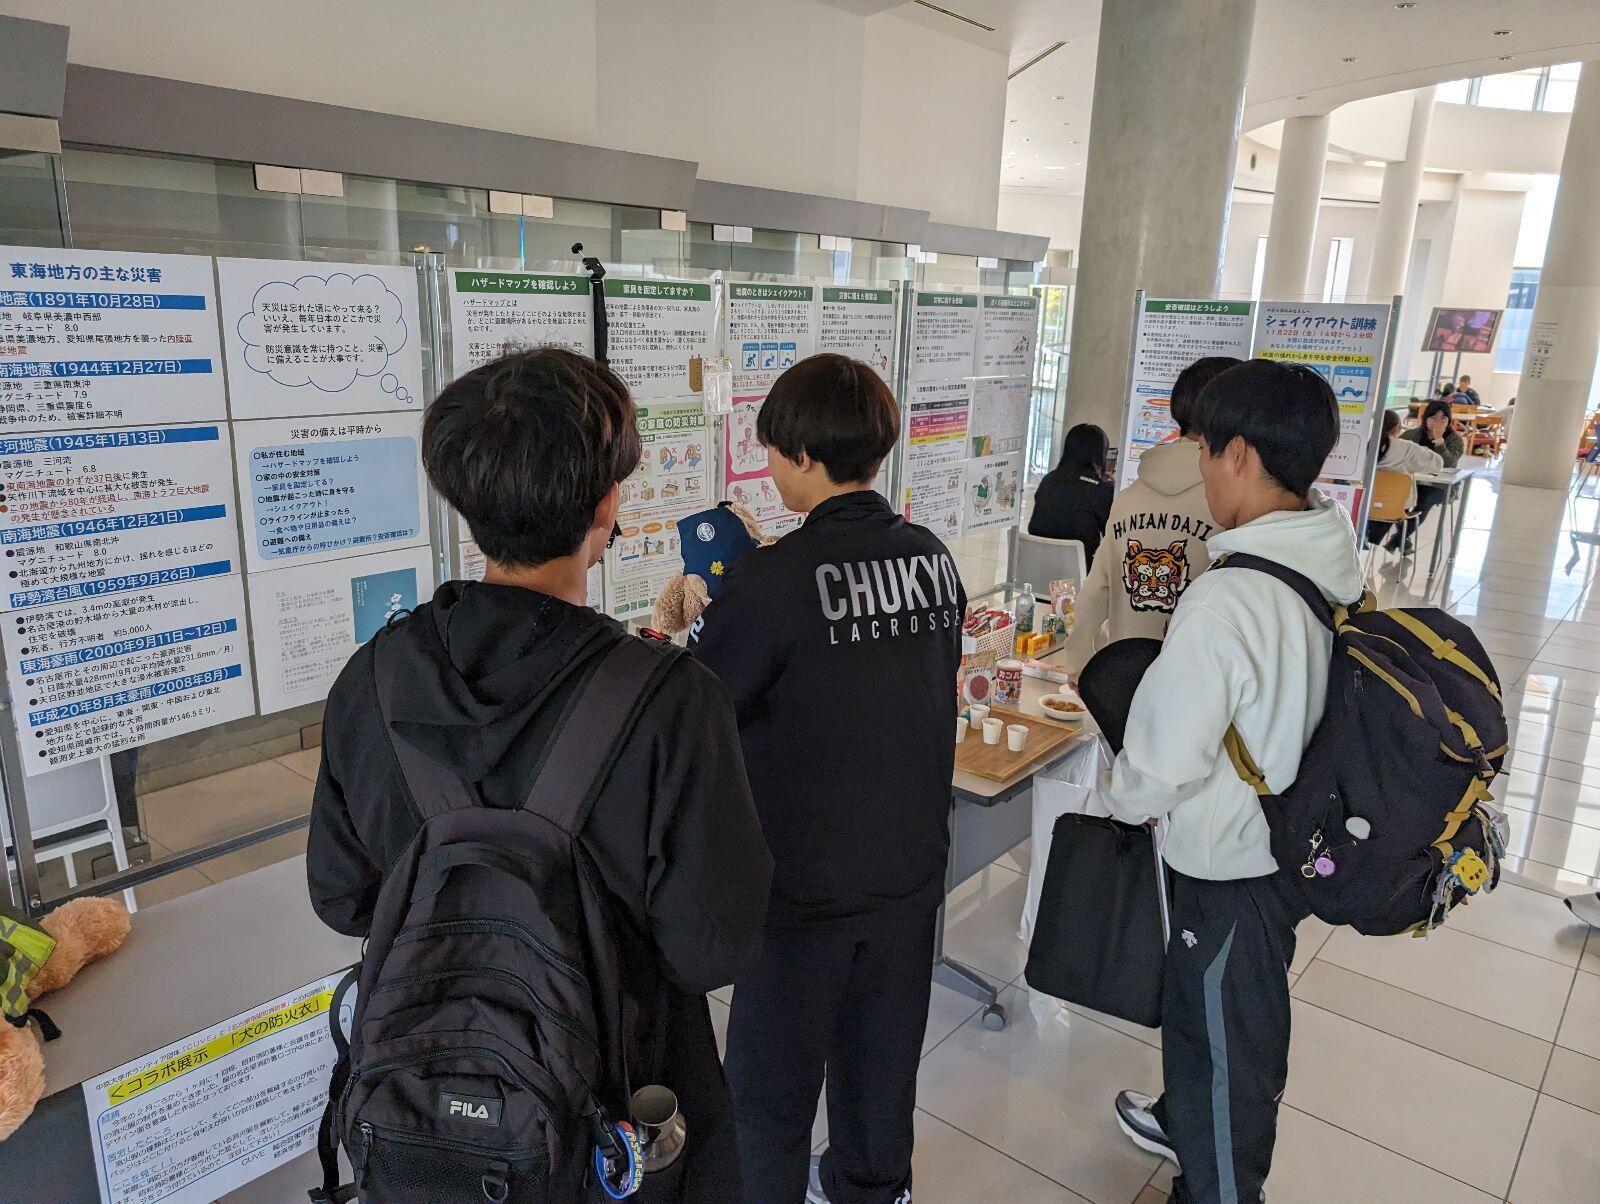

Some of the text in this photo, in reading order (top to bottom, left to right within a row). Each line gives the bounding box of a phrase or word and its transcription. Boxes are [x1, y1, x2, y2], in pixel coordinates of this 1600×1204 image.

[9, 262, 162, 284] 東海地方の主な災害
[471, 278, 577, 291] ハザードマップを確認しよう
[463, 299, 517, 307] ハザードマップとは
[264, 314, 382, 324] いいえ、毎年日本のどこかで災
[1266, 315, 1378, 331] シェイクアウト訓練
[65, 324, 79, 332] 8.0
[264, 324, 347, 334] 害が発生しています。
[265, 344, 384, 354] 防災意識を常に持つこと、災害
[267, 354, 365, 365] に備えることが大事です。
[74, 391, 88, 399] 7.9
[290, 424, 382, 440] 災害の備えは平時から
[5, 465, 97, 480] マグニチュード 6.8
[93, 548, 107, 557] 8.0
[815, 553, 957, 621] CHUKYO
[829, 608, 960, 645] LACROSSE
[449, 1100, 489, 1119] FILA
